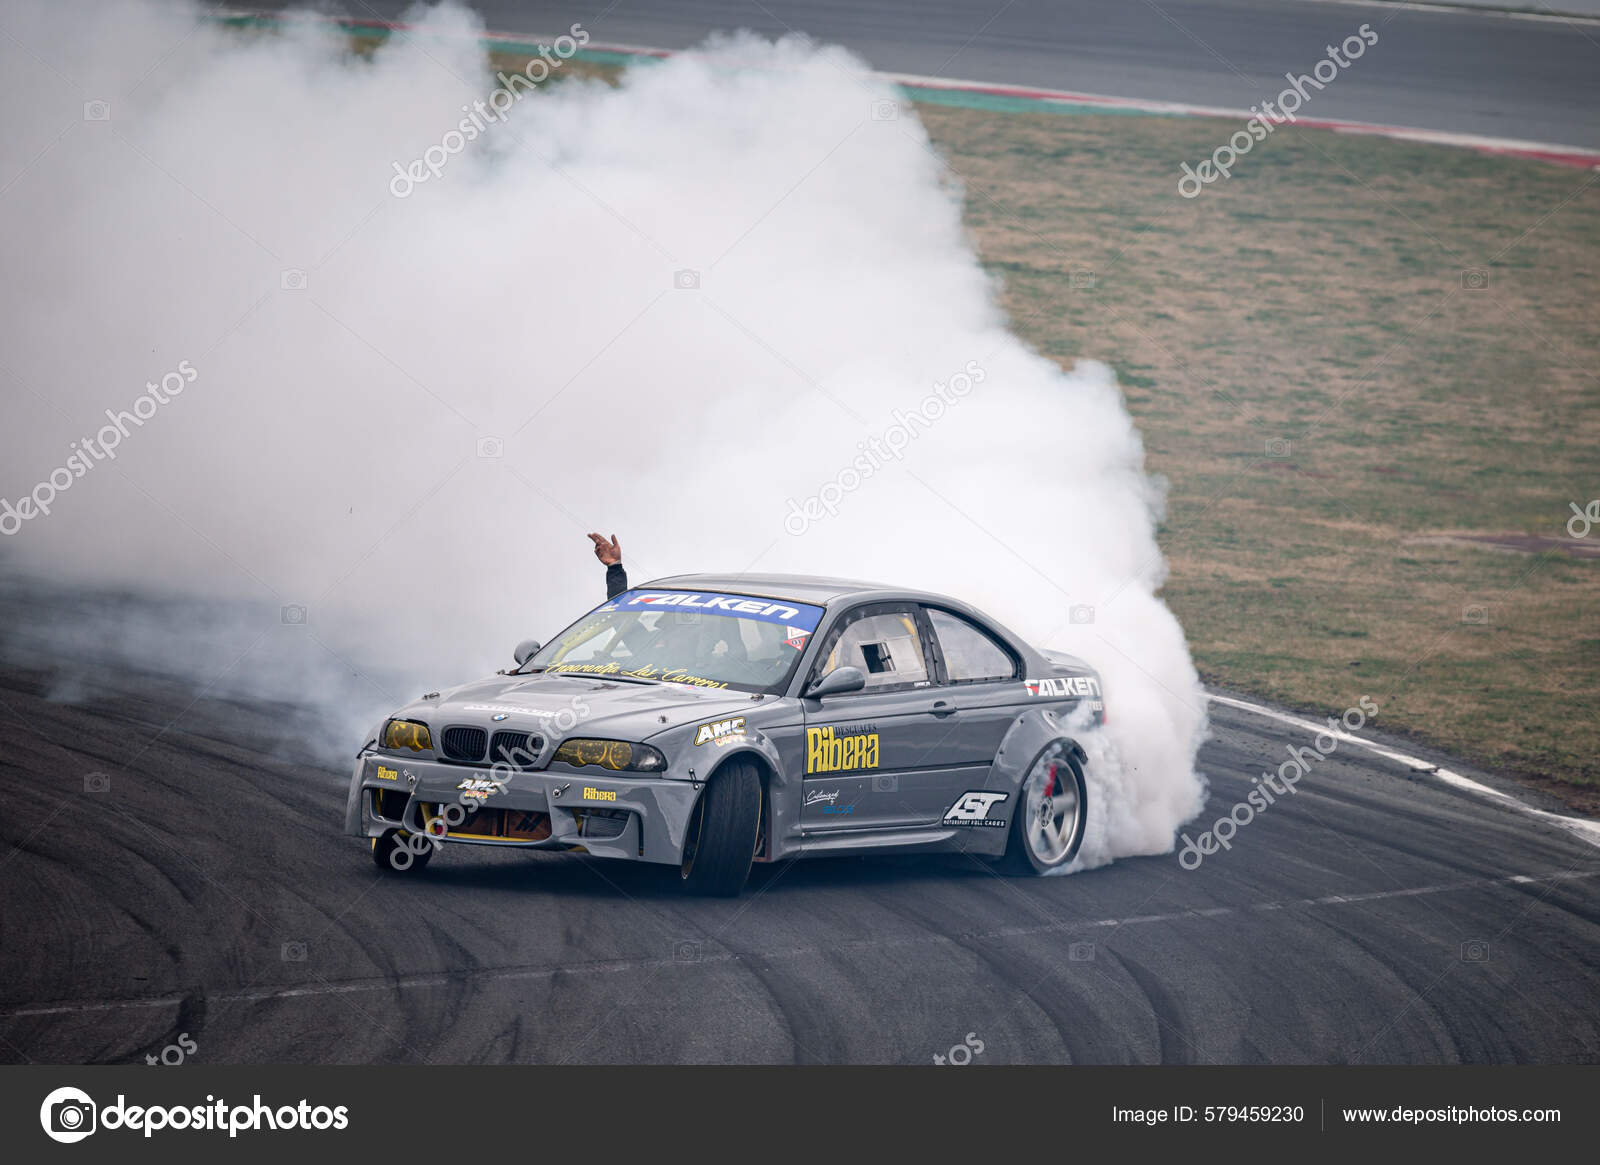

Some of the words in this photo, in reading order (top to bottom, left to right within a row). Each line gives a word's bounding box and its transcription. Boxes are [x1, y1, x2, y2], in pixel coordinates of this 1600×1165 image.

[628, 593, 799, 619] FALKEN
[621, 664, 658, 681] Las
[1024, 677, 1100, 697] FALKEN
[694, 716, 747, 746] AMC
[944, 792, 1008, 820] AST
